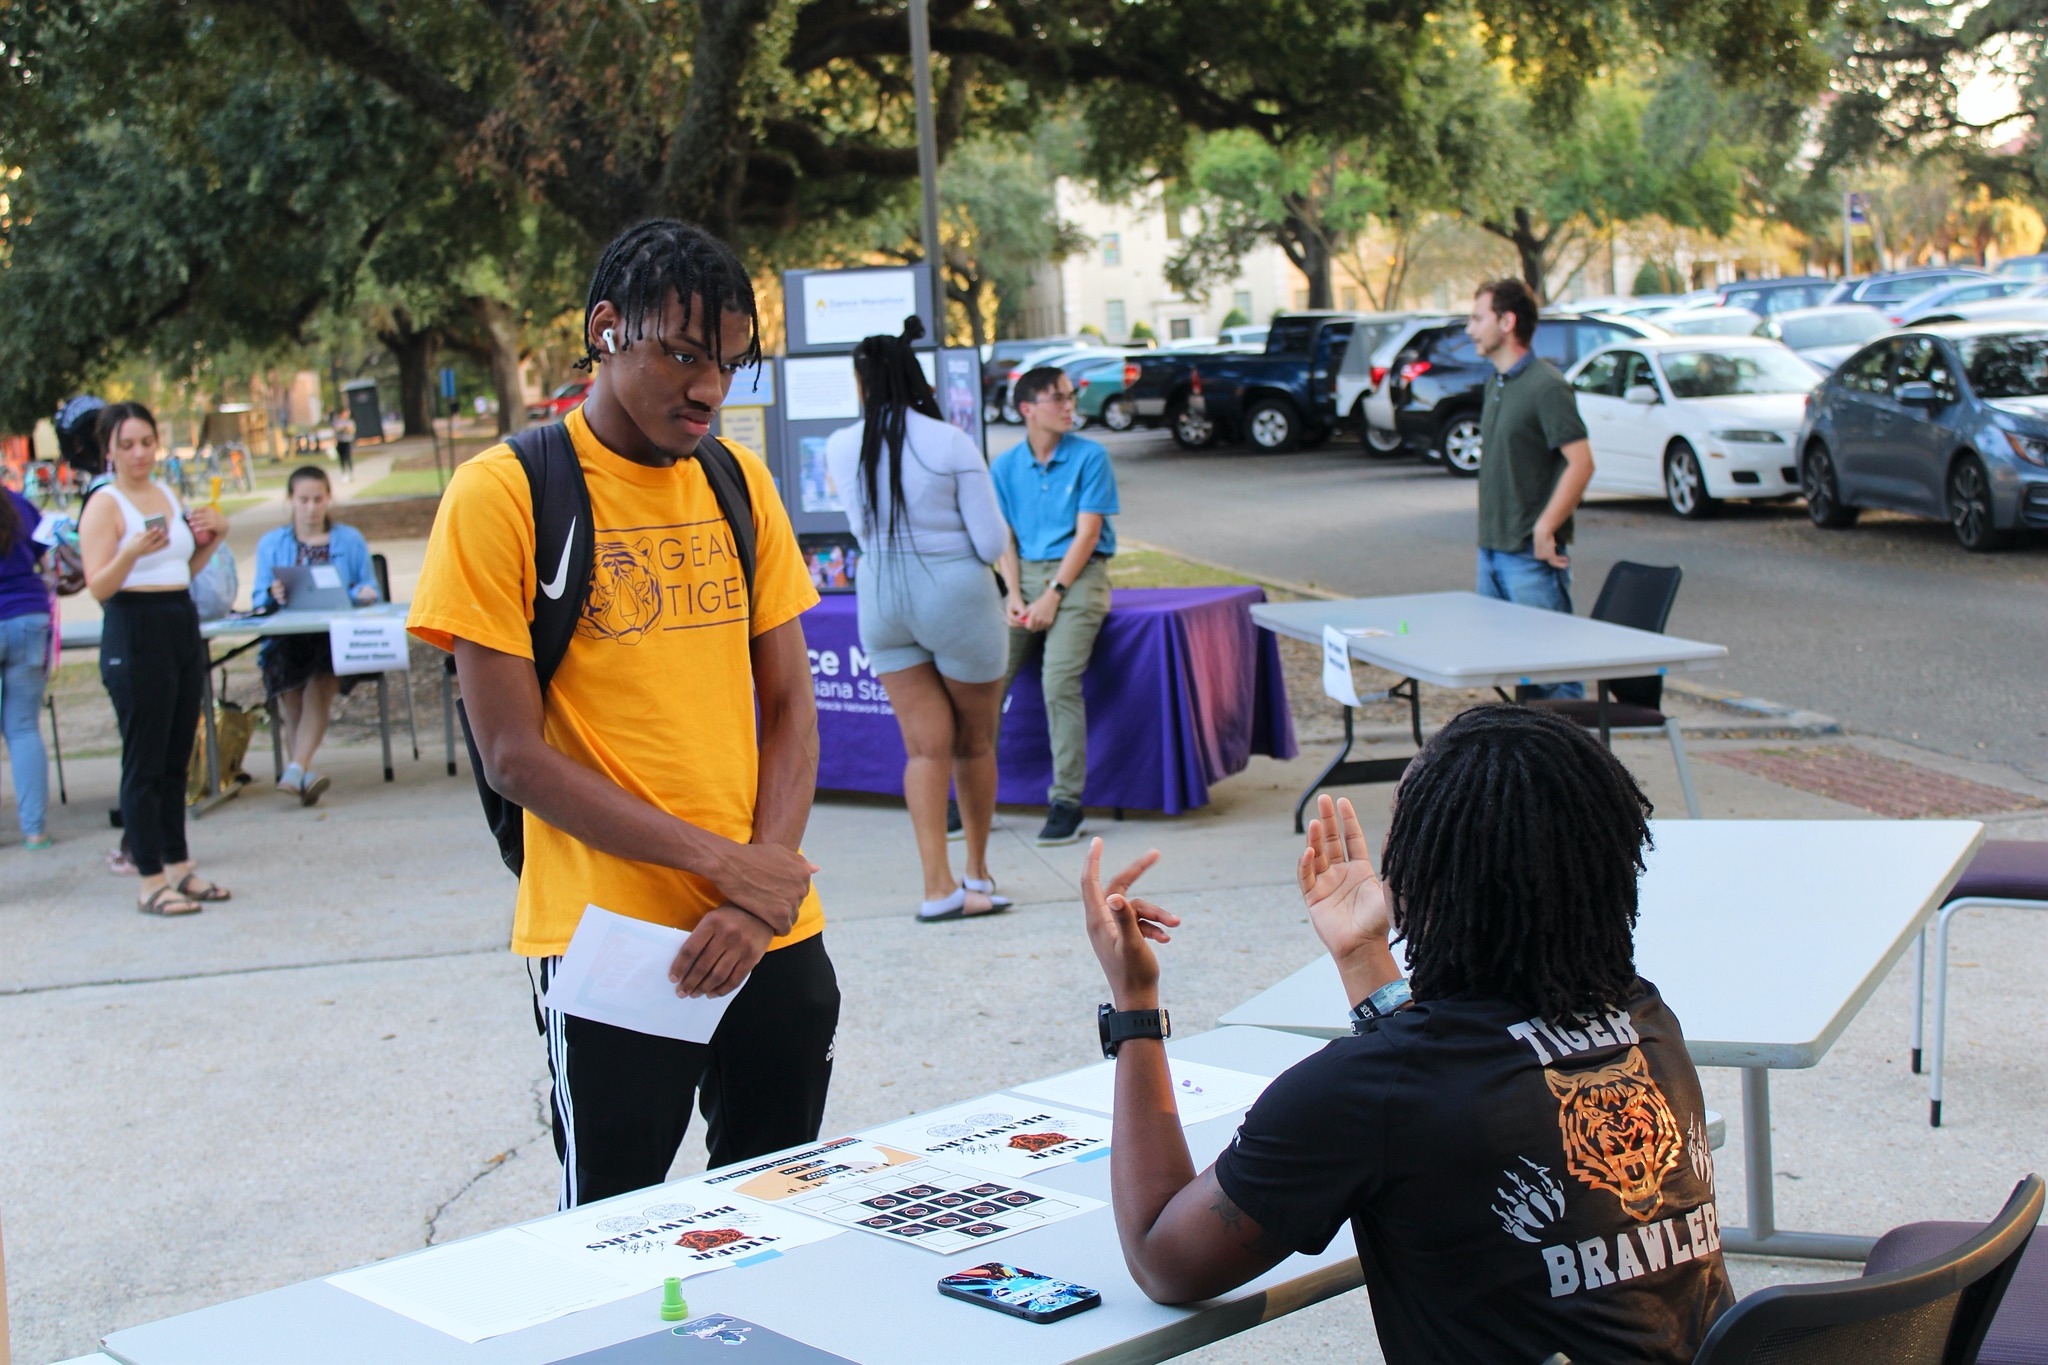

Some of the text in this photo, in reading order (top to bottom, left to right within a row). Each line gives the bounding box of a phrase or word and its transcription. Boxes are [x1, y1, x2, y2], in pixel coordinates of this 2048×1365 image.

[658, 531, 739, 571] GEAU
[813, 676, 889, 701] iana Sta
[1506, 1007, 1640, 1066] TIGER
[926, 1113, 1054, 1154] BRAWLERS
[1026, 1137, 1104, 1160] TIGER
[585, 1205, 738, 1252] BRAWLERS
[687, 1235, 782, 1261] TIGER
